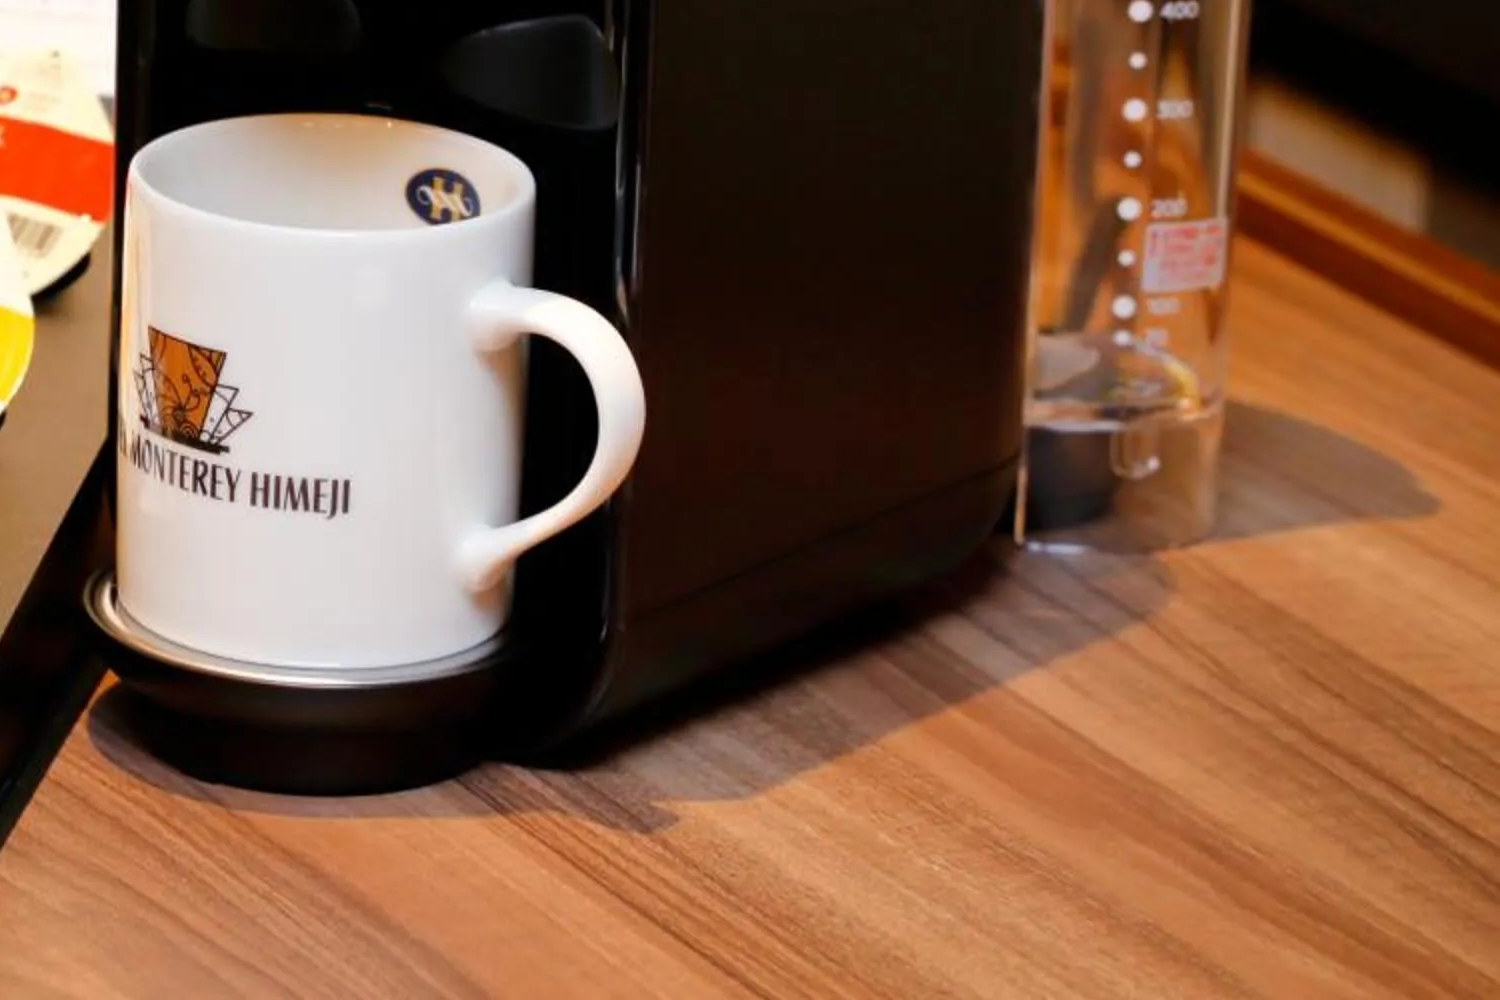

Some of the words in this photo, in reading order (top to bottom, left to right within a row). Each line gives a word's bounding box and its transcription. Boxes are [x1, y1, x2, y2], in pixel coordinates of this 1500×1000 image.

[1160, 0, 1200, 20] 400
[130, 431, 242, 502] MONTEREY
[250, 472, 351, 520] HIMEJI
